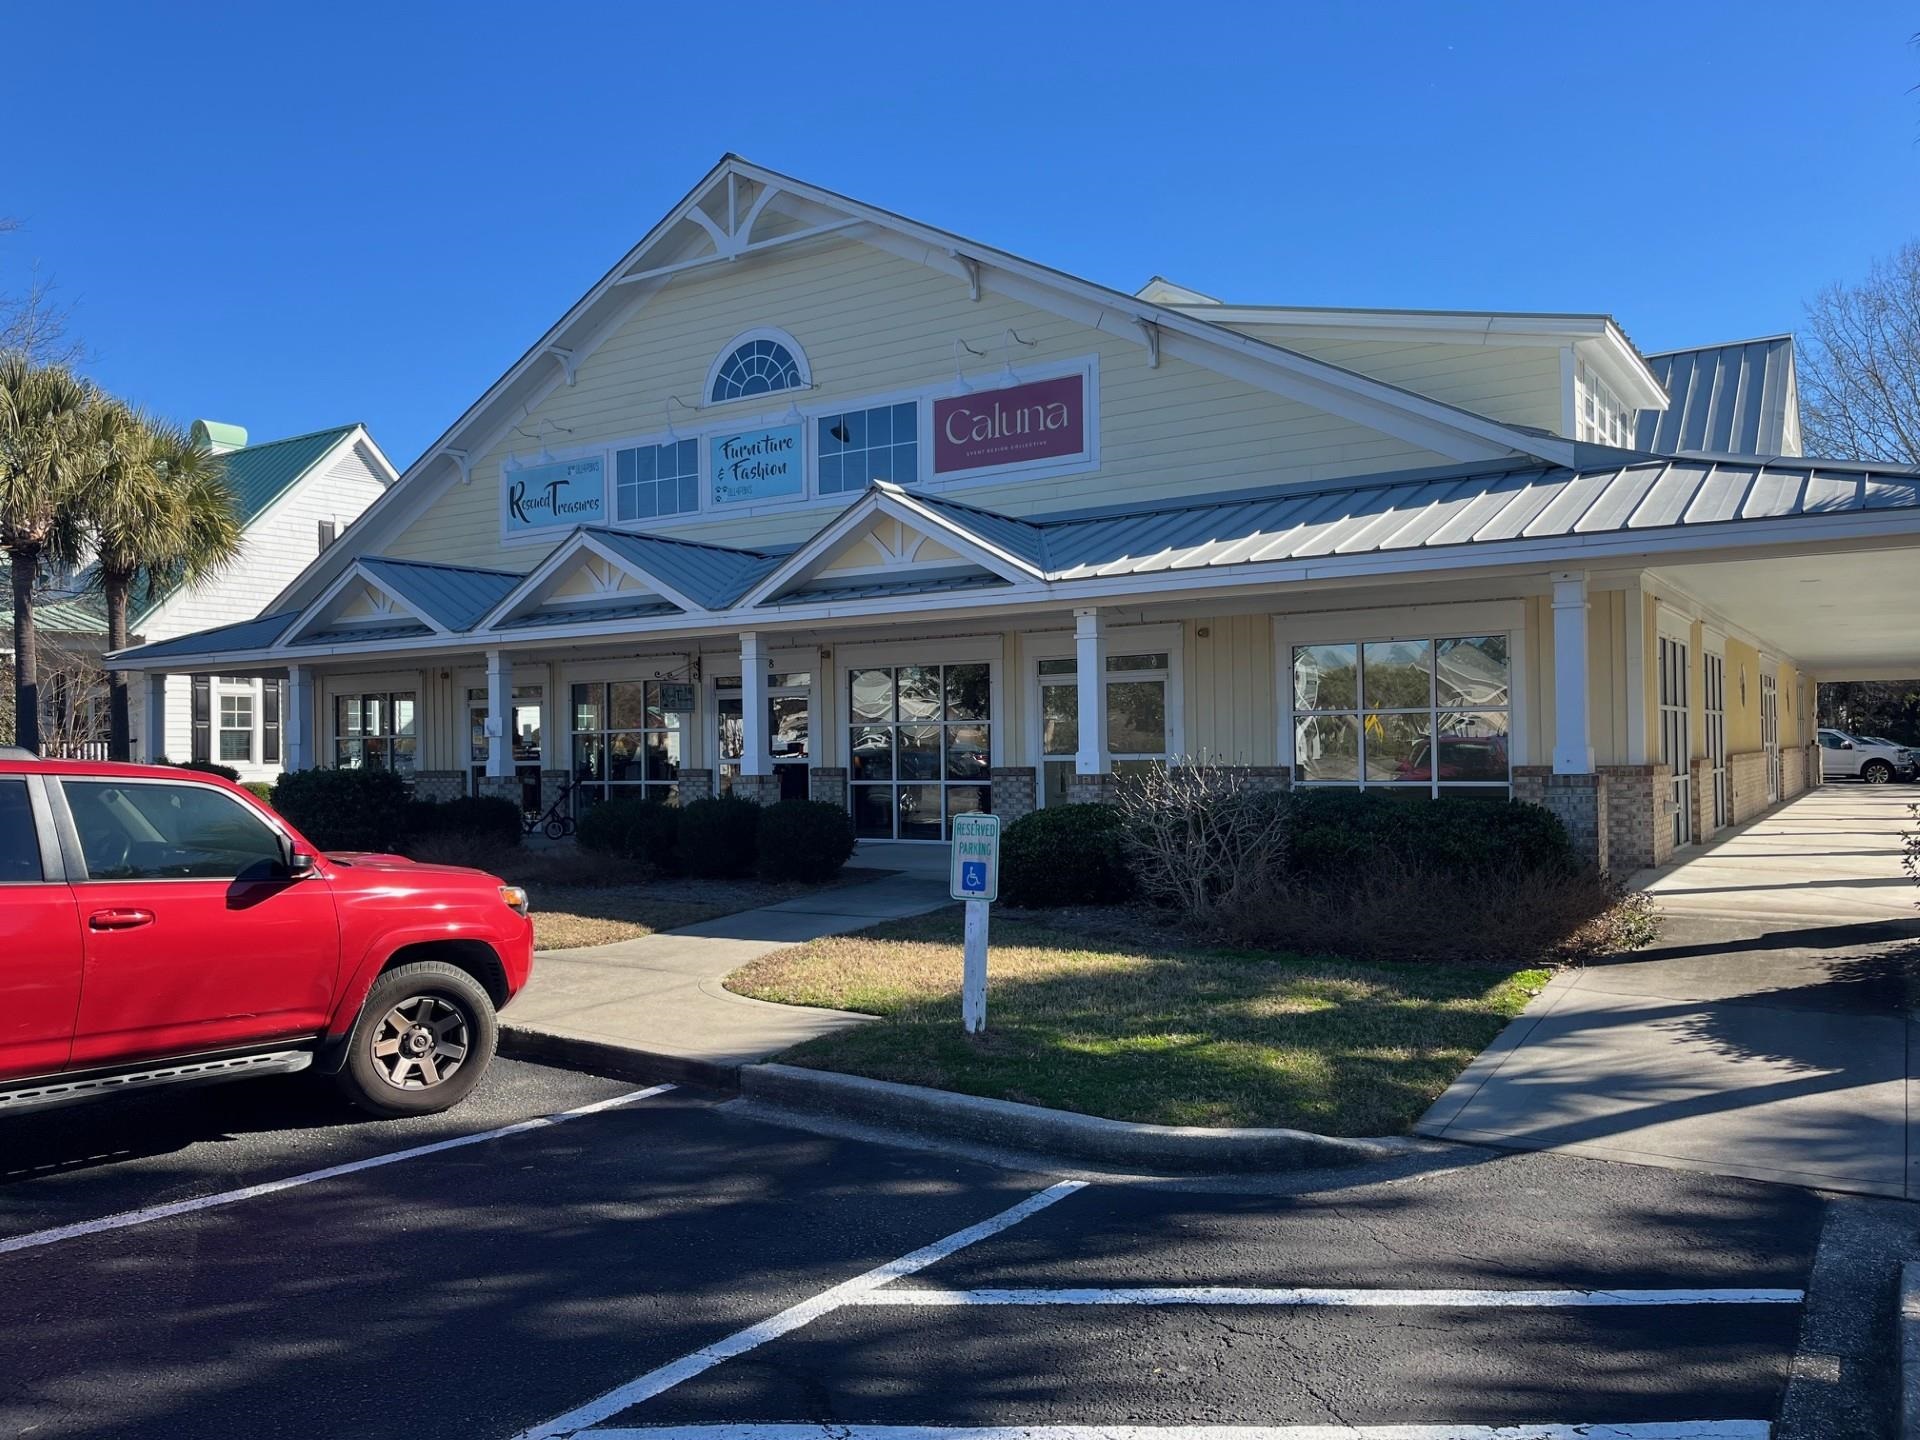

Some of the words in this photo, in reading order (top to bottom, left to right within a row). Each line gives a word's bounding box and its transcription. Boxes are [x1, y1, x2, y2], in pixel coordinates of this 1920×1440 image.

[945, 402, 1069, 445] Caluna
[719, 435, 793, 460] Furniture
[728, 458, 787, 480] Fashion
[509, 480, 551, 523] Rescued
[544, 480, 600, 516] Treasures
[957, 822, 995, 836] RESERVED
[959, 842, 992, 856] PARKING
